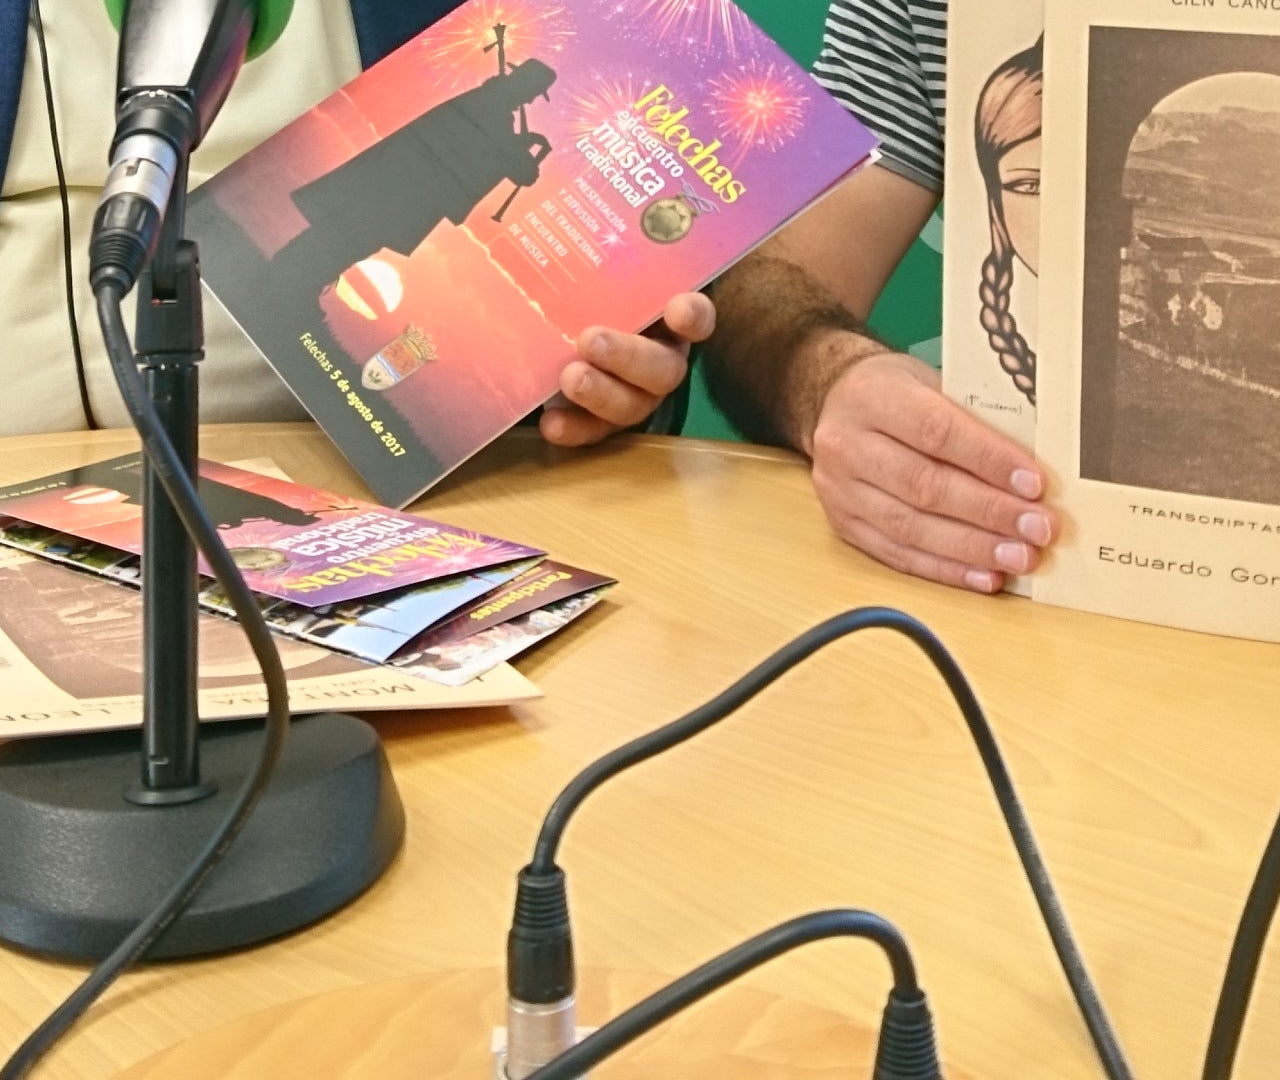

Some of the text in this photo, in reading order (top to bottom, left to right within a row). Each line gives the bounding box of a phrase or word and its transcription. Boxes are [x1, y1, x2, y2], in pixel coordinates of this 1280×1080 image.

[576, 136, 649, 208] tradicional
[592, 120, 665, 196] música
[617, 110, 684, 178] encuentro
[633, 84, 747, 204] Felechas
[508, 223, 523, 237] DE
[525, 212, 568, 257] ENCUENTRO
[541, 200, 603, 267] DEL TRADICIONAL
[558, 187, 600, 233] Y DIFUSIÓN
[573, 176, 627, 233] PRESENTACIÓN
[300, 332, 406, 457] Felechas 5 de agosto de 2017
[1098, 546, 1213, 578] Eduardo
